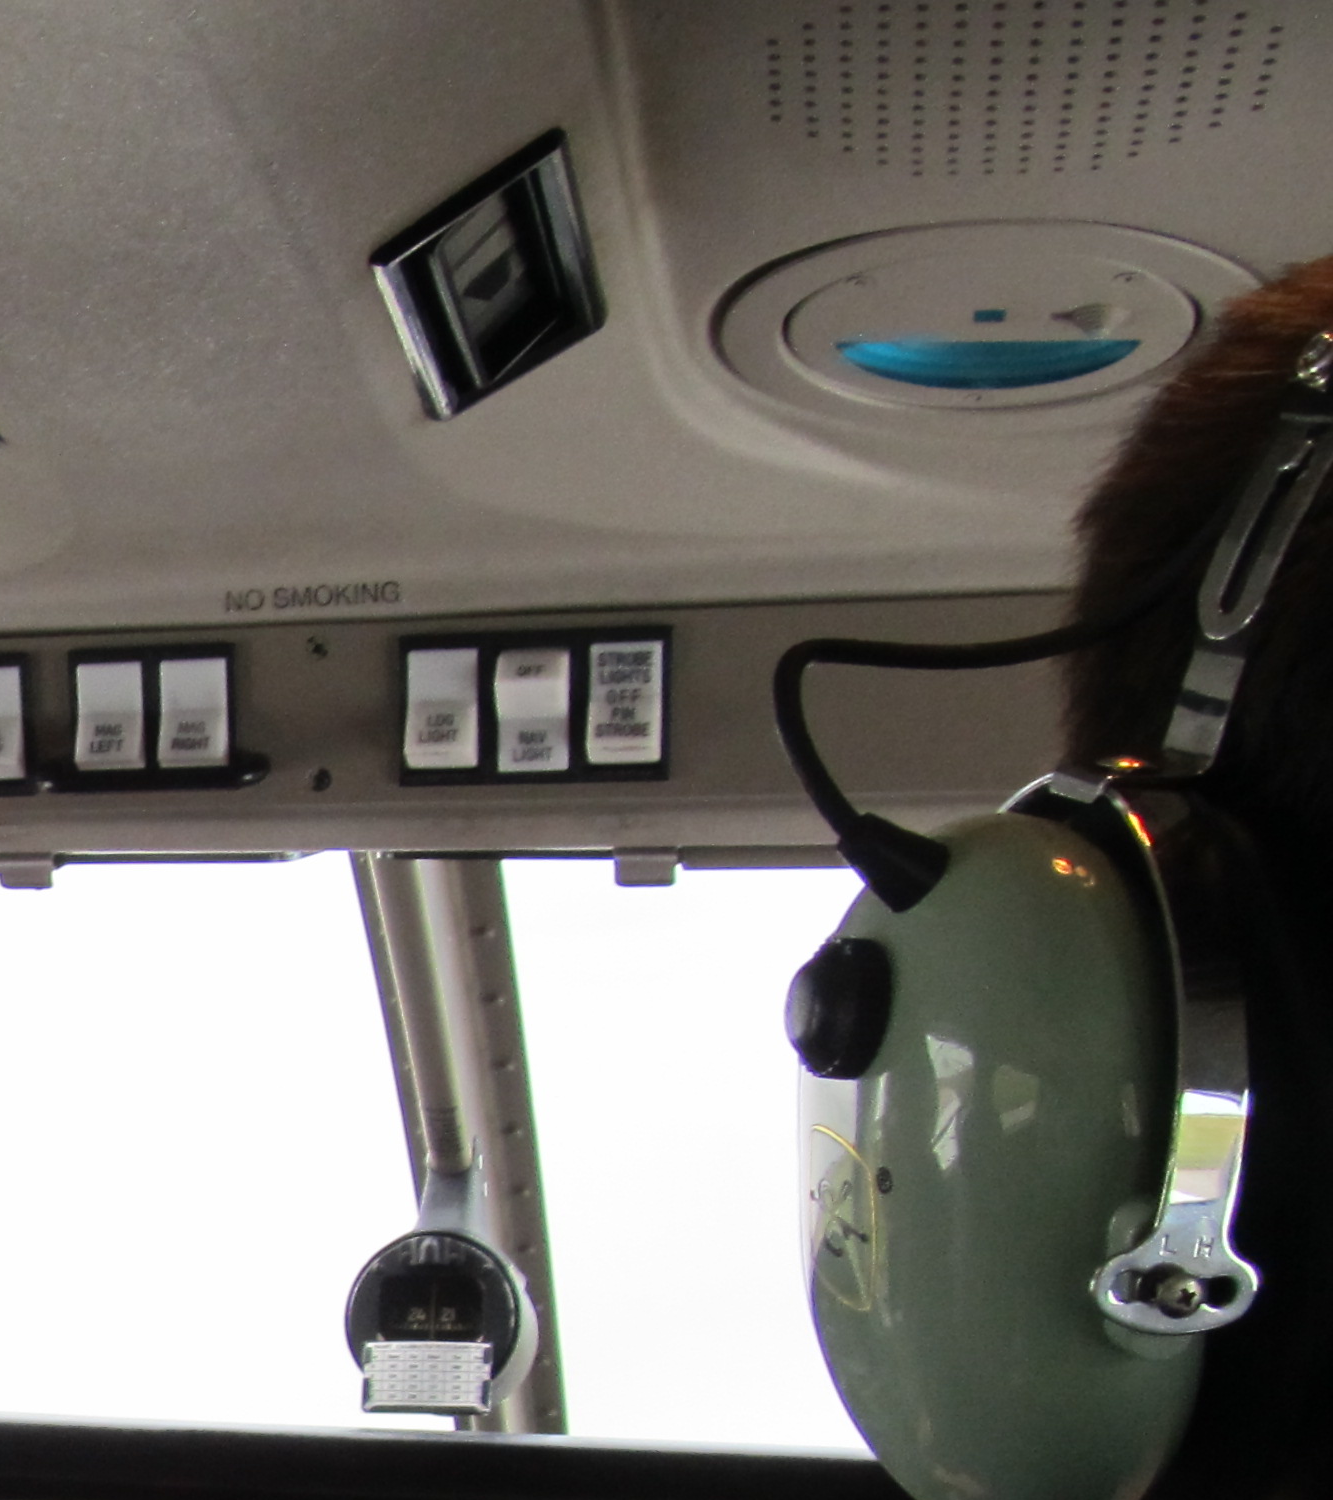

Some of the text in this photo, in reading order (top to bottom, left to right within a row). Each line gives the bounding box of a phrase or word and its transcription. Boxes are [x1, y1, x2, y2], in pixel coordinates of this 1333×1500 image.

[225, 581, 401, 612] NO SMOKING
[597, 651, 653, 667] STROBE
[517, 664, 545, 677] OFF
[606, 689, 642, 705] OFF
[419, 729, 459, 743] LIGHT
[595, 722, 651, 738] STROBE
[90, 739, 124, 753] LEFT
[171, 737, 210, 751] RIGHT
[513, 747, 553, 762] LIGHT
[1159, 1234, 1215, 1258] L H
